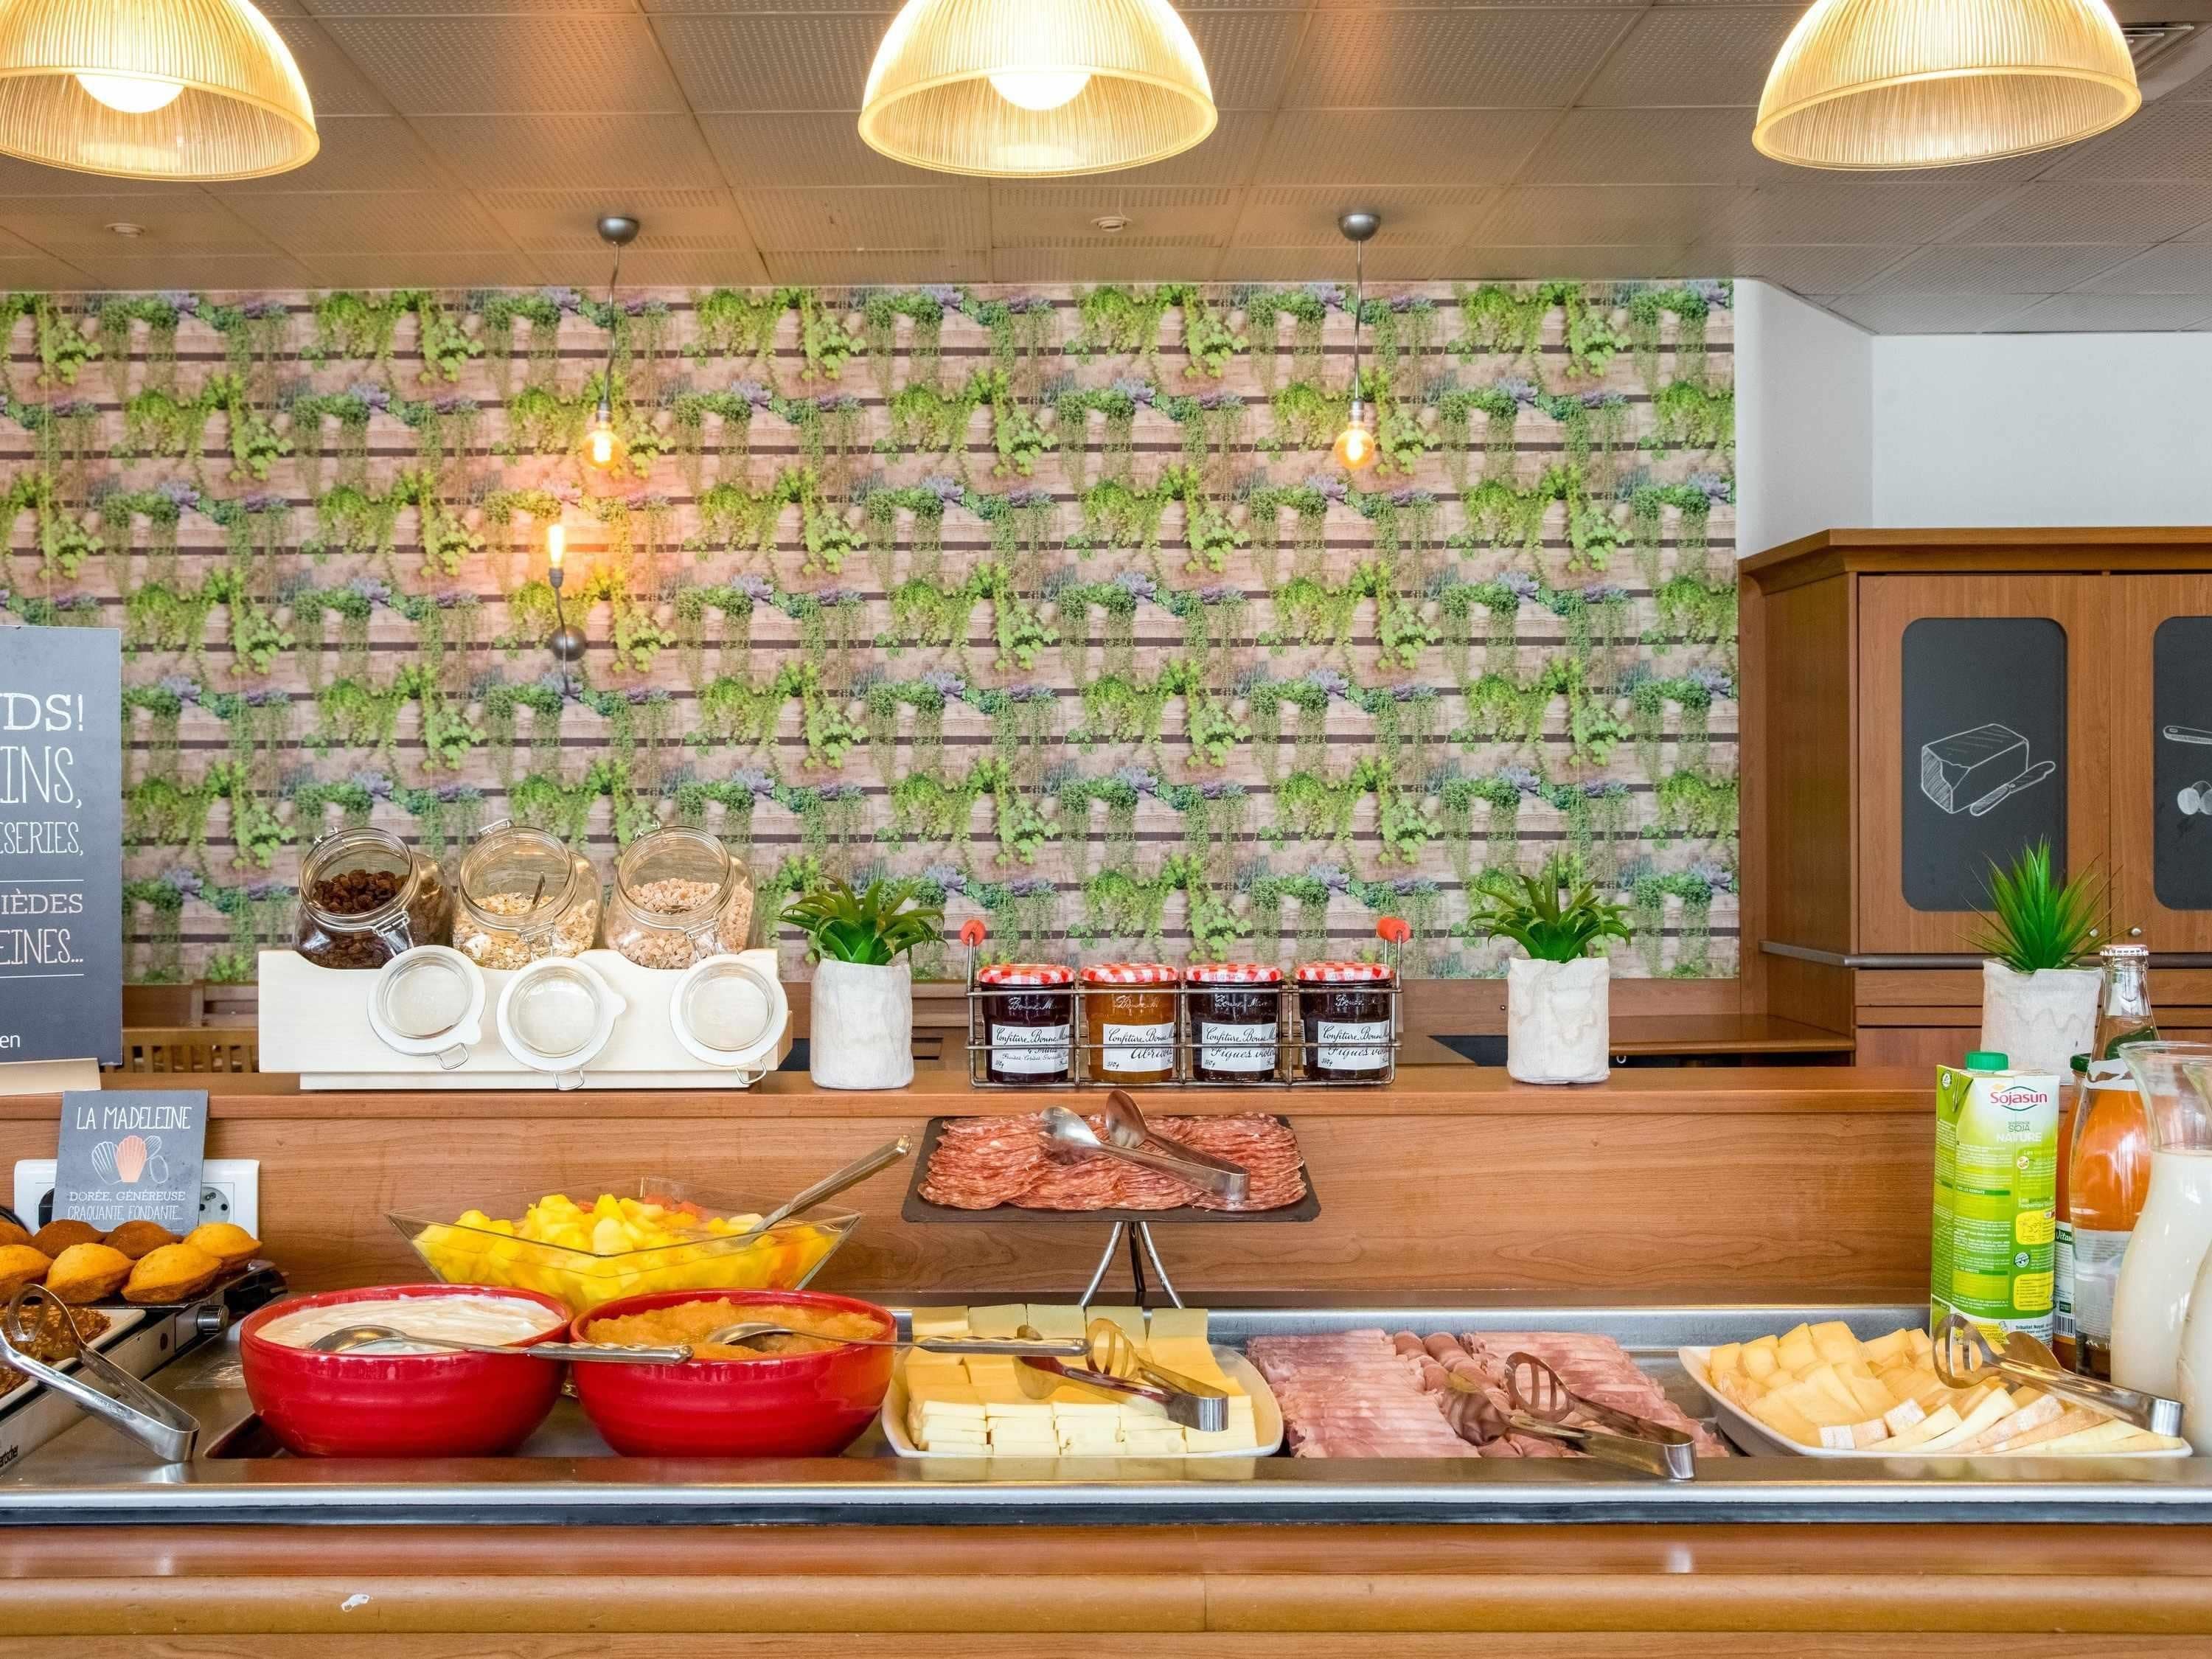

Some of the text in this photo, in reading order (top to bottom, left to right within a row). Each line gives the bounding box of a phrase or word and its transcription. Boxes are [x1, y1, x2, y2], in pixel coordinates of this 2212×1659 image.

[0, 692, 83, 731] DS!
[0, 746, 82, 809] INS,
[0, 821, 83, 856] SERIES,
[996, 1027, 1029, 1044] Confiture
[1031, 1028, 1057, 1043] Bonne
[1108, 1027, 1143, 1044] Confiture
[1206, 1026, 1240, 1044] Confiture
[1323, 1025, 1358, 1043] Confiture
[1211, 1046, 1253, 1062] Figues
[1328, 1046, 1368, 1060] Figues
[1990, 1091, 2048, 1106] Sojasun
[76, 1106, 192, 1130] LA MADELEINE
[2007, 1124, 2030, 1133] SOJA
[1996, 1133, 2042, 1143] NATURE
[69, 1190, 186, 1203] DORÉE, GÉNÉREUSE
